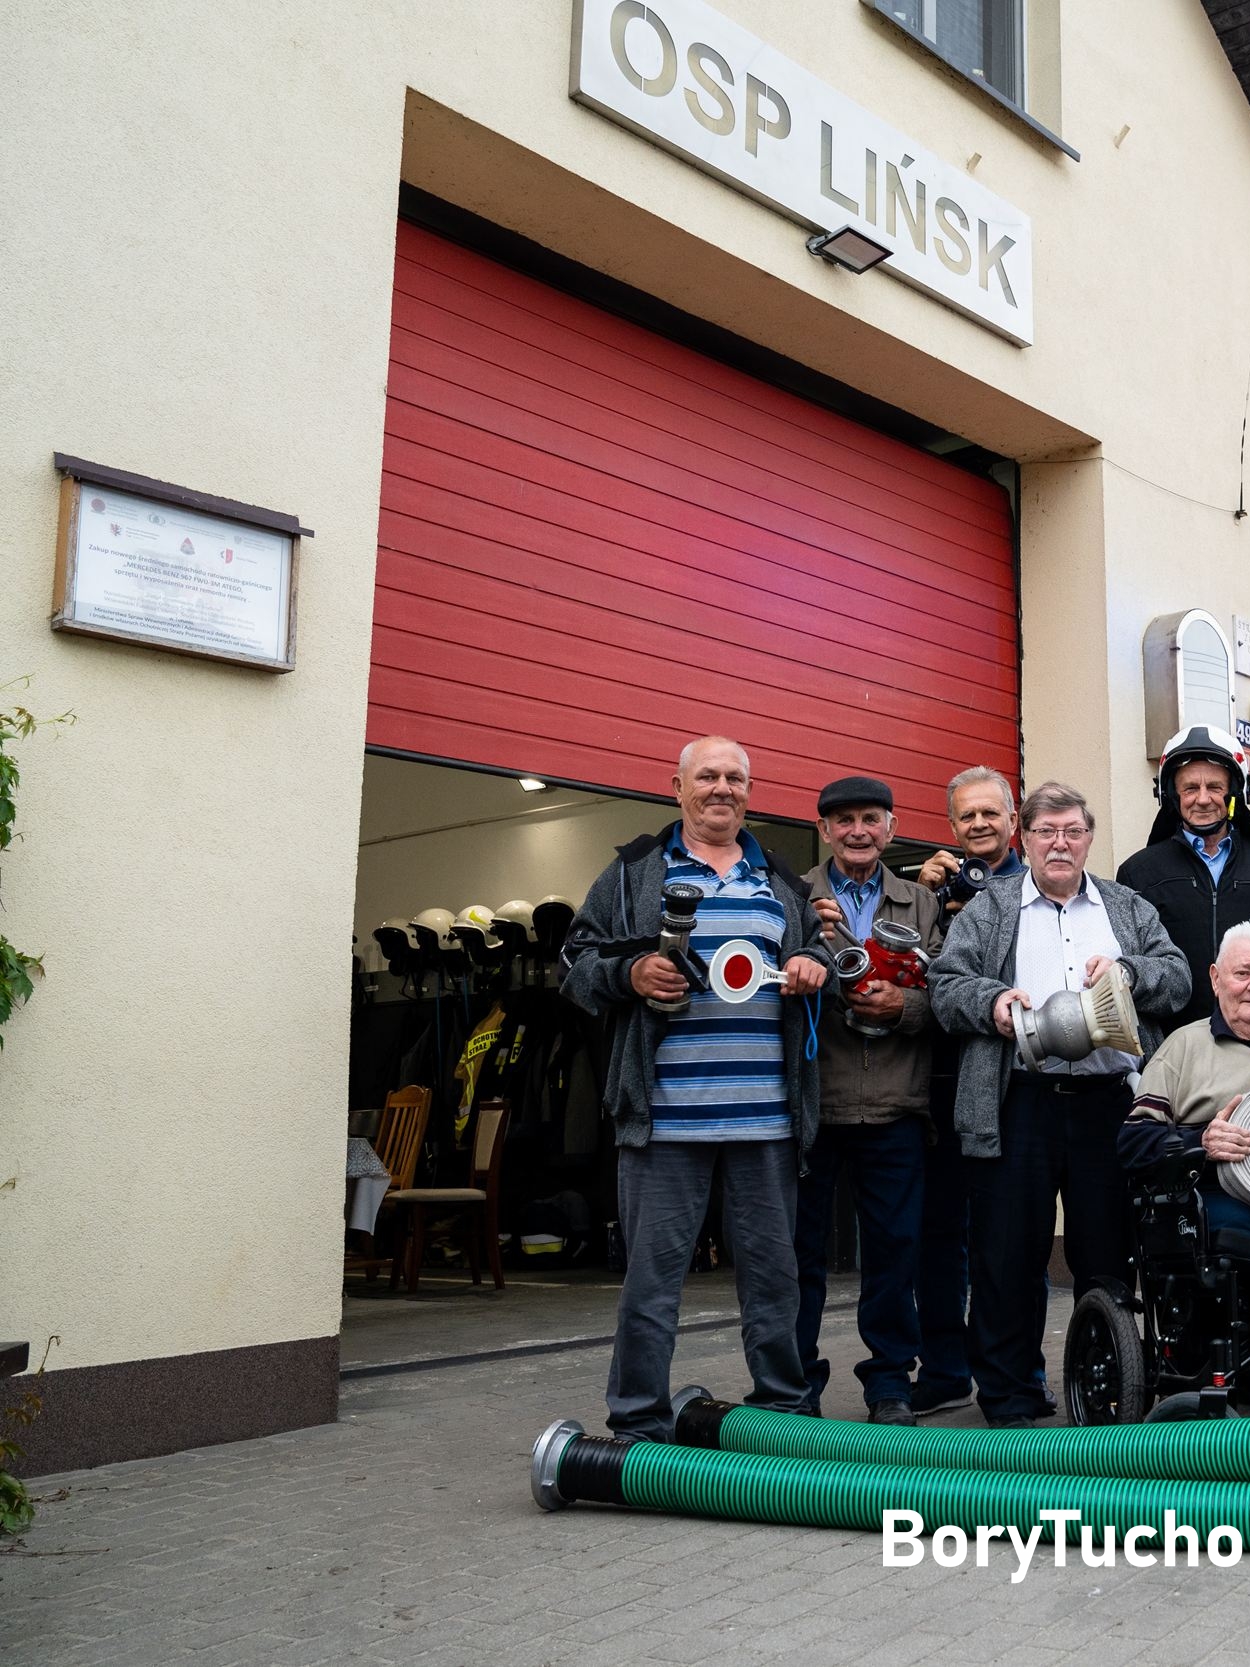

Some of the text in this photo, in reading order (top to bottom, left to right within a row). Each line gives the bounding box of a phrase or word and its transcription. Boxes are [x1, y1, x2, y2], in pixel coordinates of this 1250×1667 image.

[609, 0, 1018, 309] OSP LIŃSK
[88, 543, 109, 554] Zakup
[110, 549, 136, 560] nowego
